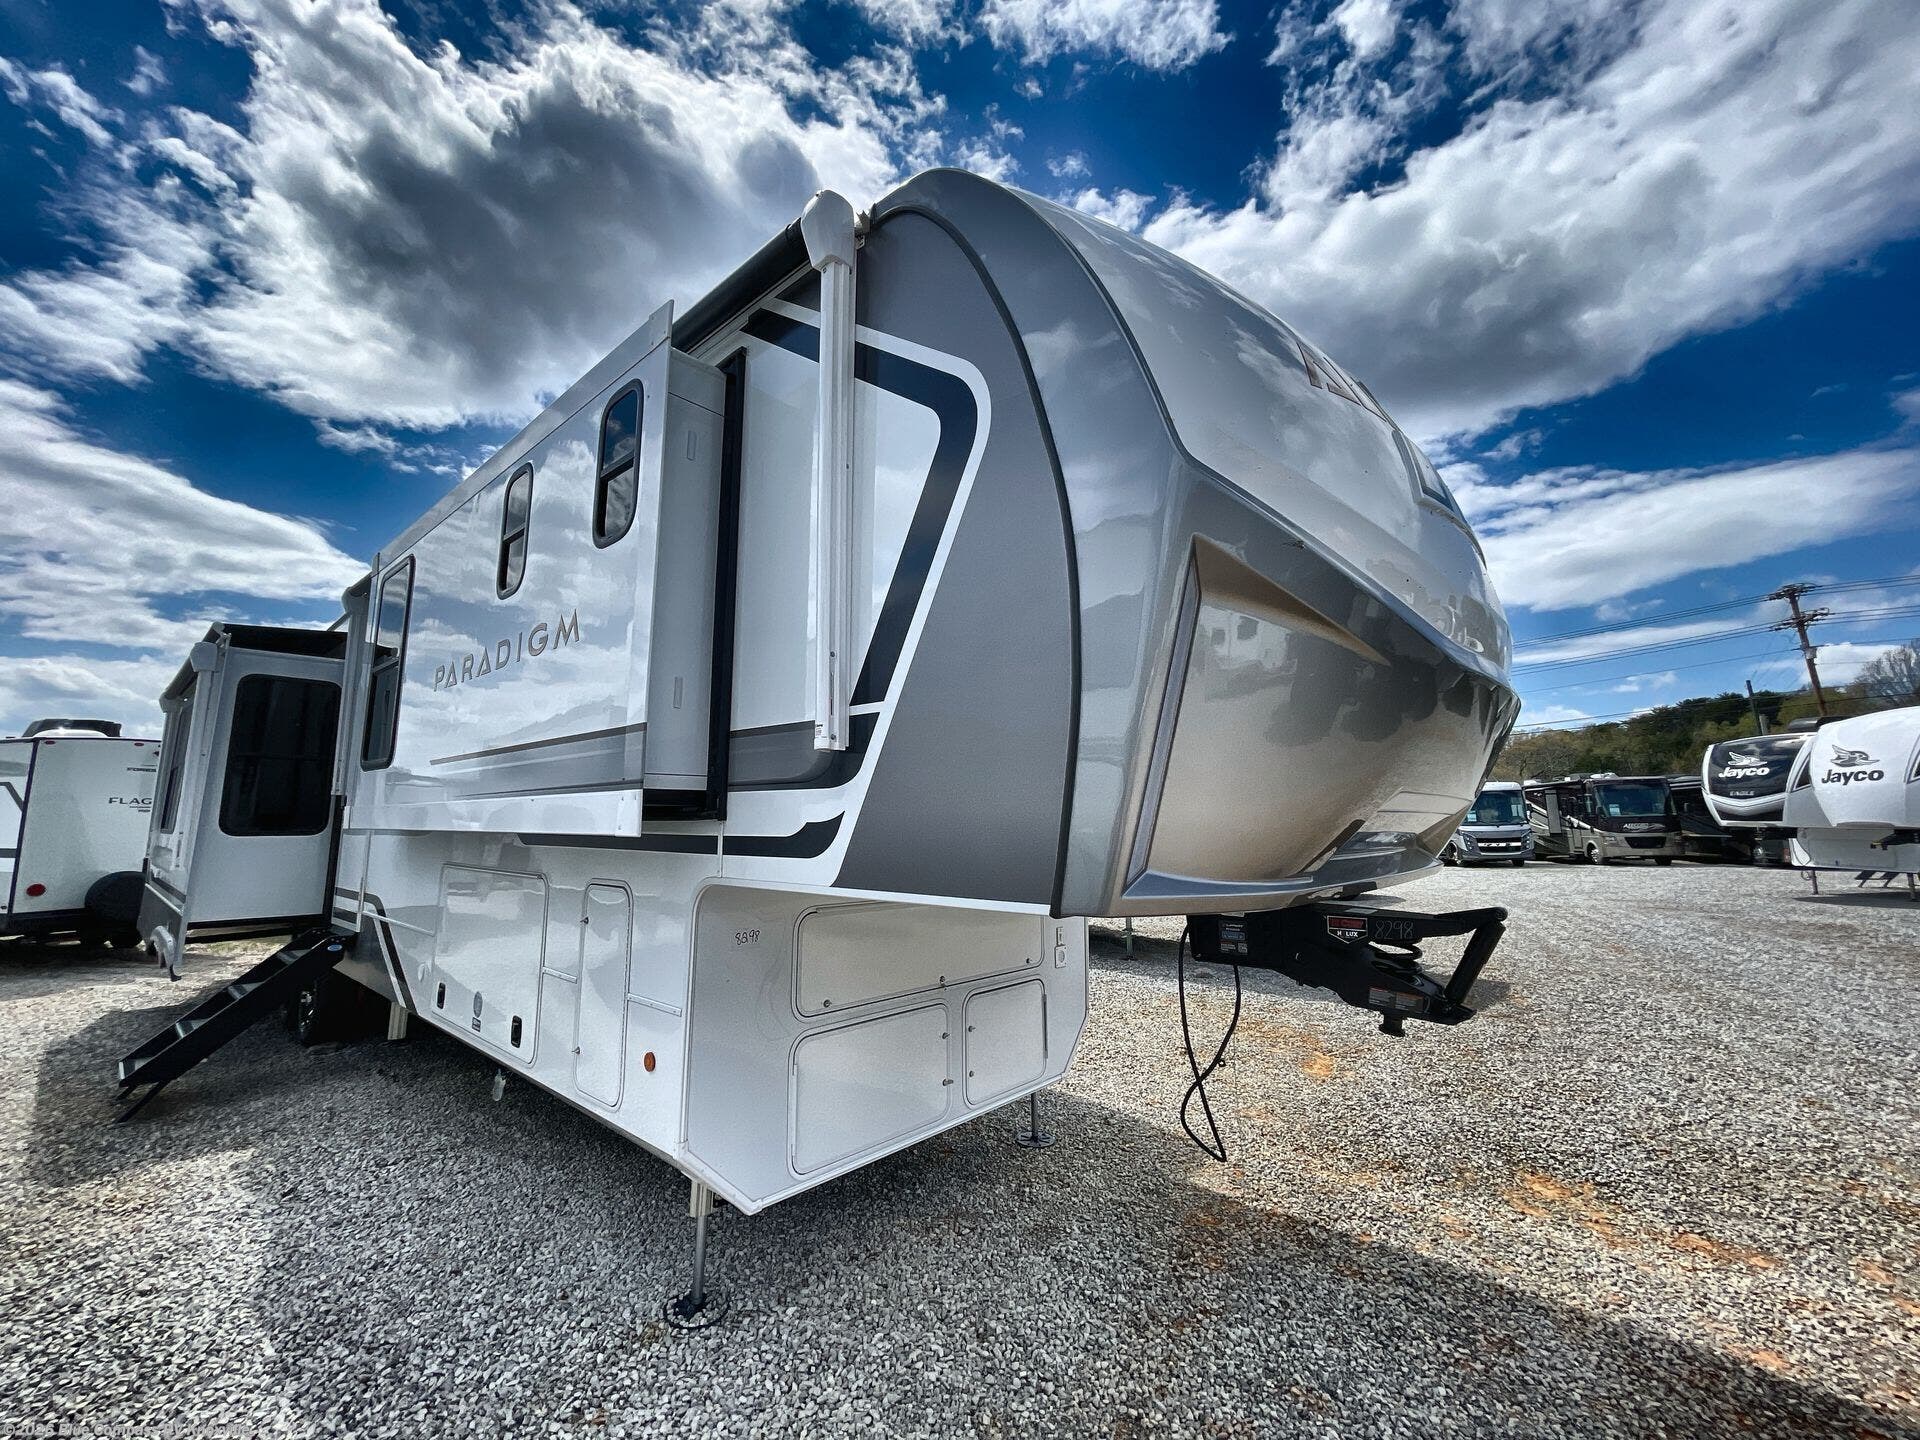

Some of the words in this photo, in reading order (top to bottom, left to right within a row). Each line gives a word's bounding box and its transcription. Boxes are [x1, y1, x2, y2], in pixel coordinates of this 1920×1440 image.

[433, 609, 580, 692] PARADIGM
[1718, 767, 1770, 779] Jayco
[1821, 769, 1884, 785] Jayco
[1375, 920, 1414, 940] 8298
